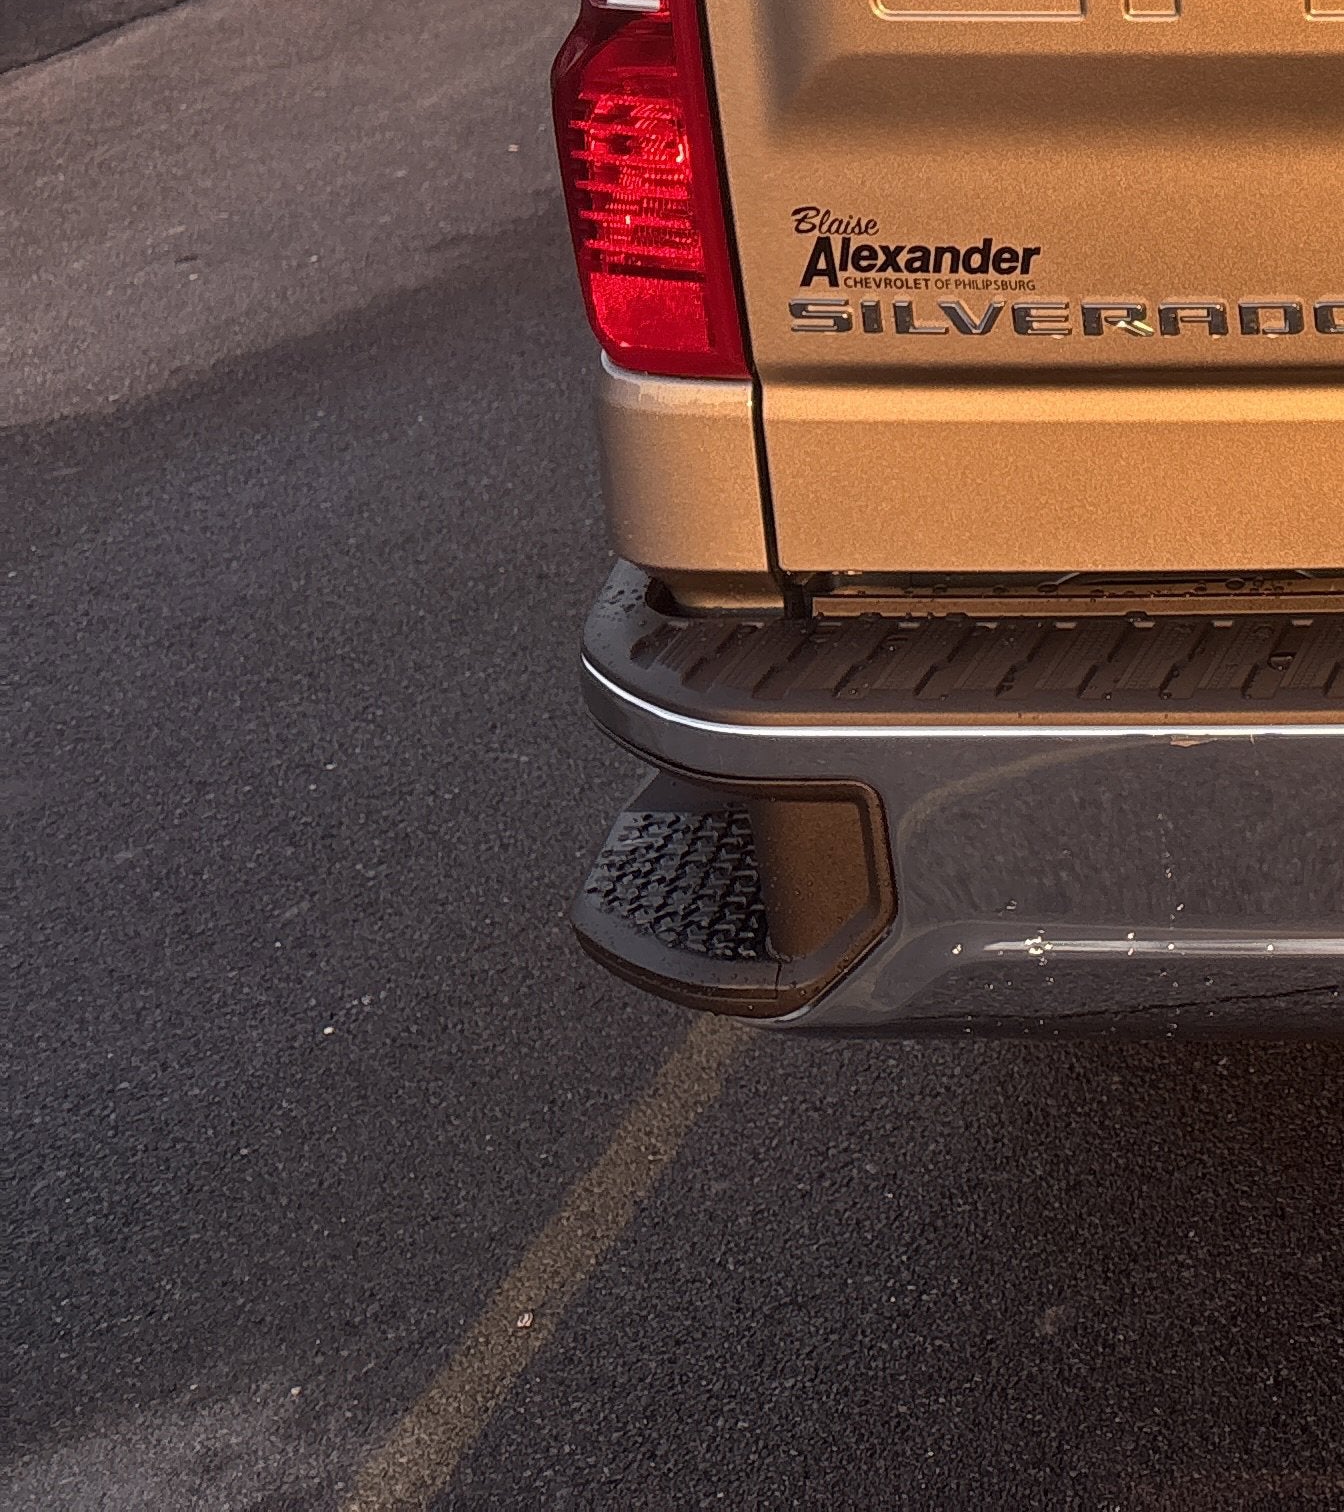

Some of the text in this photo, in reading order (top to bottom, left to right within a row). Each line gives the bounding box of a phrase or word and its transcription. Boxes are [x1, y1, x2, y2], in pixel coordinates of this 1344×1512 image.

[791, 205, 880, 236] Blaise
[800, 236, 1041, 287] Alexander
[843, 276, 1036, 291] CHEVROLET OF PHILIPSBURG
